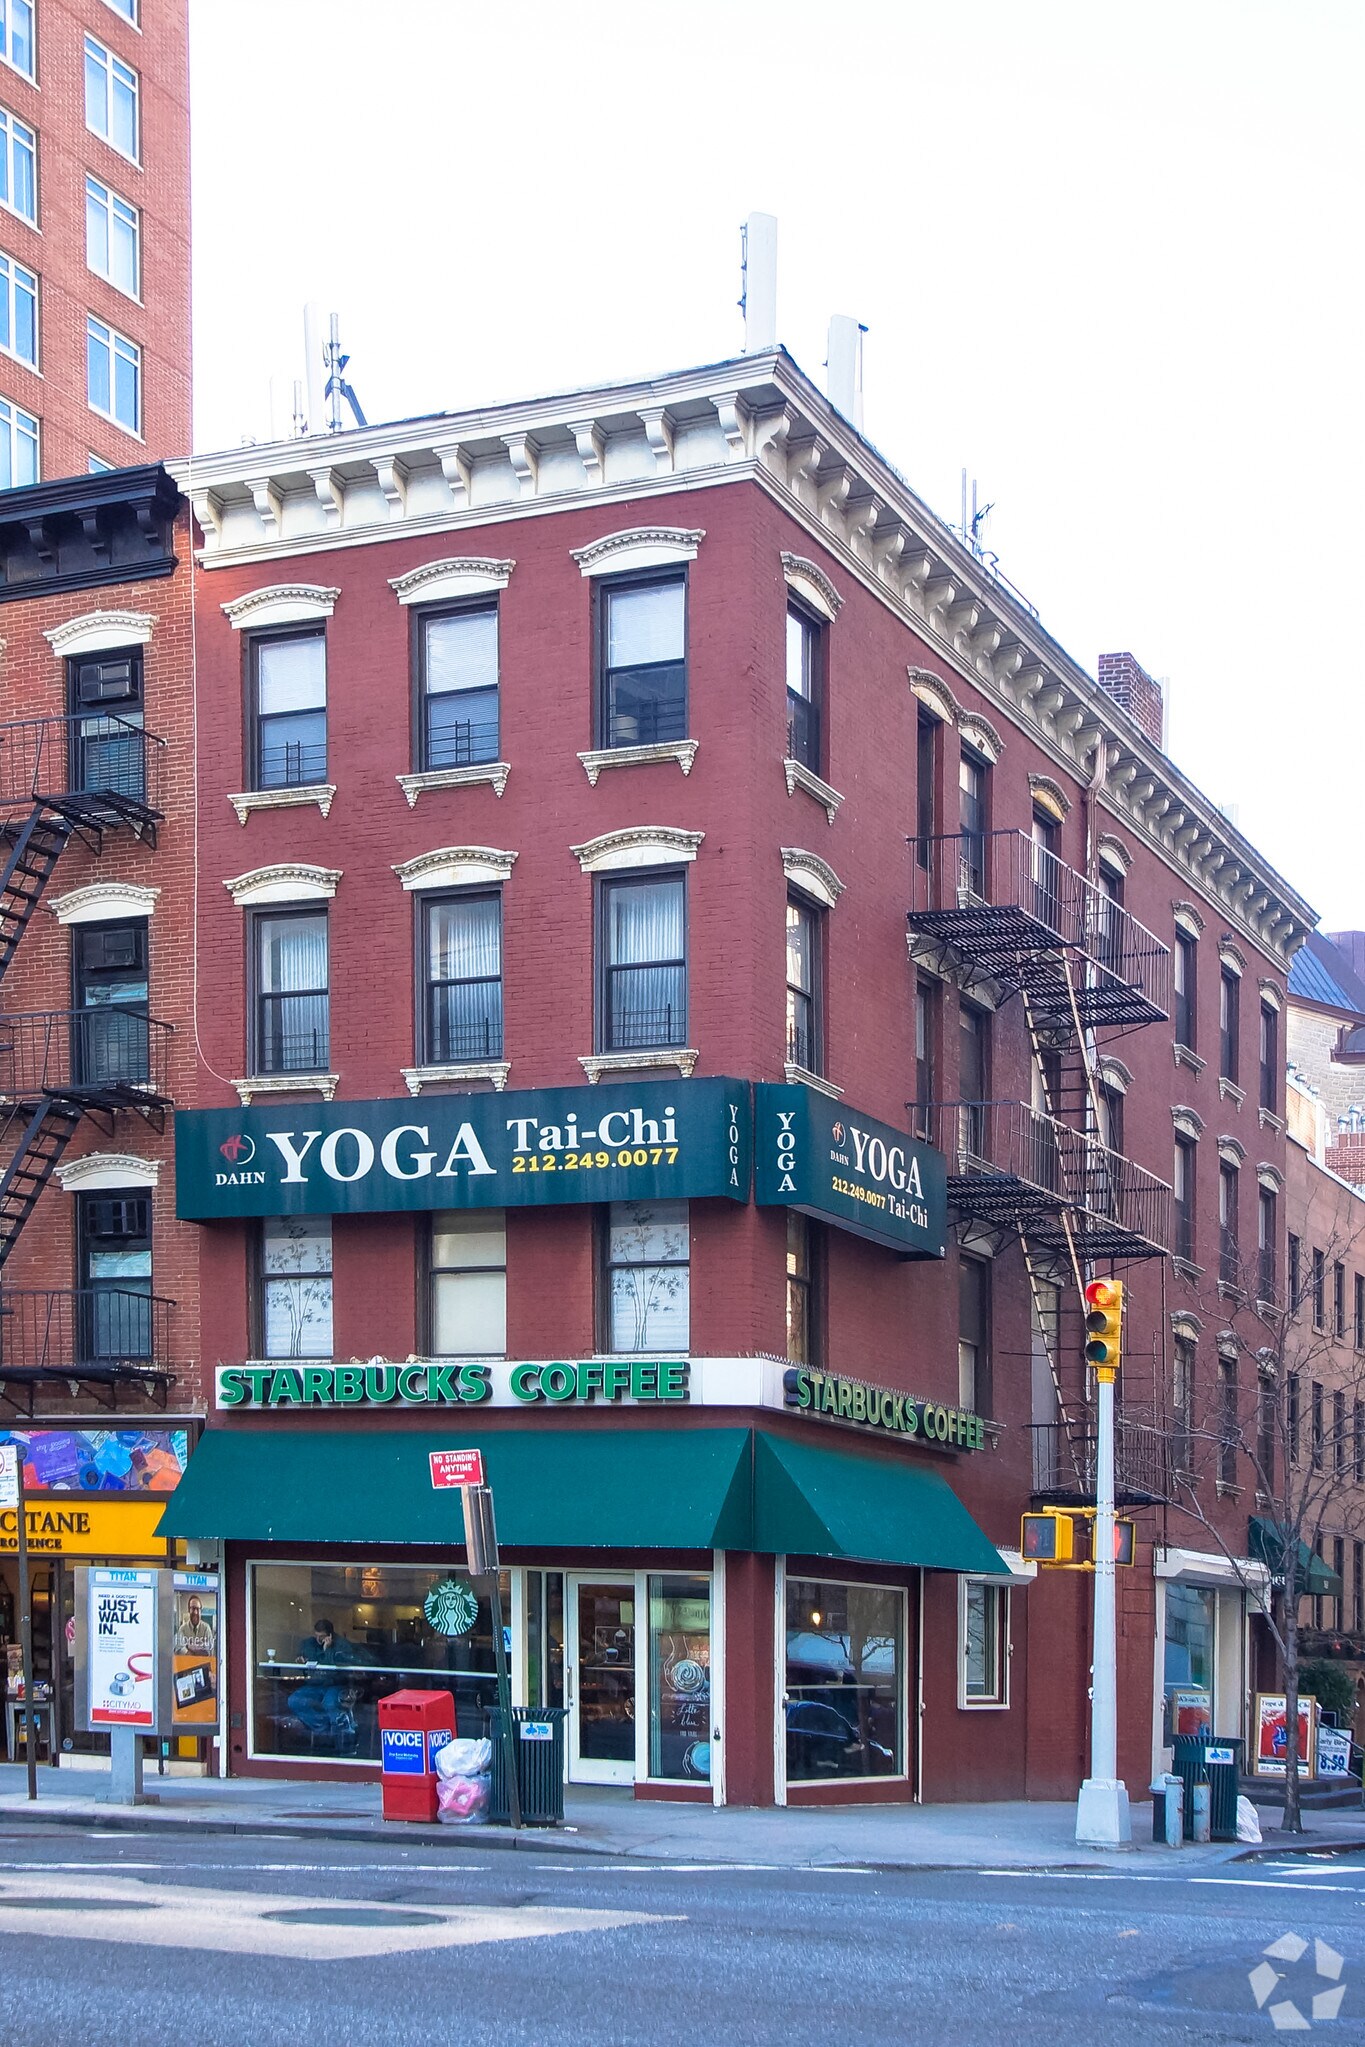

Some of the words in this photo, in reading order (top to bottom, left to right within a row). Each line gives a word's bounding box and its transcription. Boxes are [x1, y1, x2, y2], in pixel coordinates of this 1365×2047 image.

[266, 1123, 497, 1184] YOGA
[507, 1106, 678, 1152] Tai-Chi
[729, 1104, 739, 1187] YOGA
[776, 1112, 797, 1192] YOGA
[512, 1147, 678, 1173] 212.249.0077
[830, 1150, 849, 1167] DAHN
[850, 1126, 924, 1200] YOGA
[215, 1172, 265, 1186] DAHN
[832, 1176, 886, 1209] 212.249.0077
[888, 1193, 928, 1228] Tai-Chi
[219, 1362, 490, 1404] STARBUCKS
[509, 1361, 688, 1403] COFFEE
[796, 1369, 918, 1434] STARBUCKS
[923, 1402, 985, 1450] COFFEE
[433, 1455, 443, 1464] NO
[445, 1453, 477, 1463] STANDING
[440, 1463, 473, 1473] ANYTIME
[0, 1511, 91, 1533] CTANE
[0, 1537, 62, 1548] ROENCE
[109, 1571, 137, 1581] TITAN
[185, 1574, 208, 1586] TITAN
[98, 1599, 137, 1611] JUST
[98, 1611, 139, 1624] WALK
[98, 1623, 117, 1635] IN.
[387, 1732, 422, 1747] VOICE
[430, 1731, 450, 1748] VOICE
